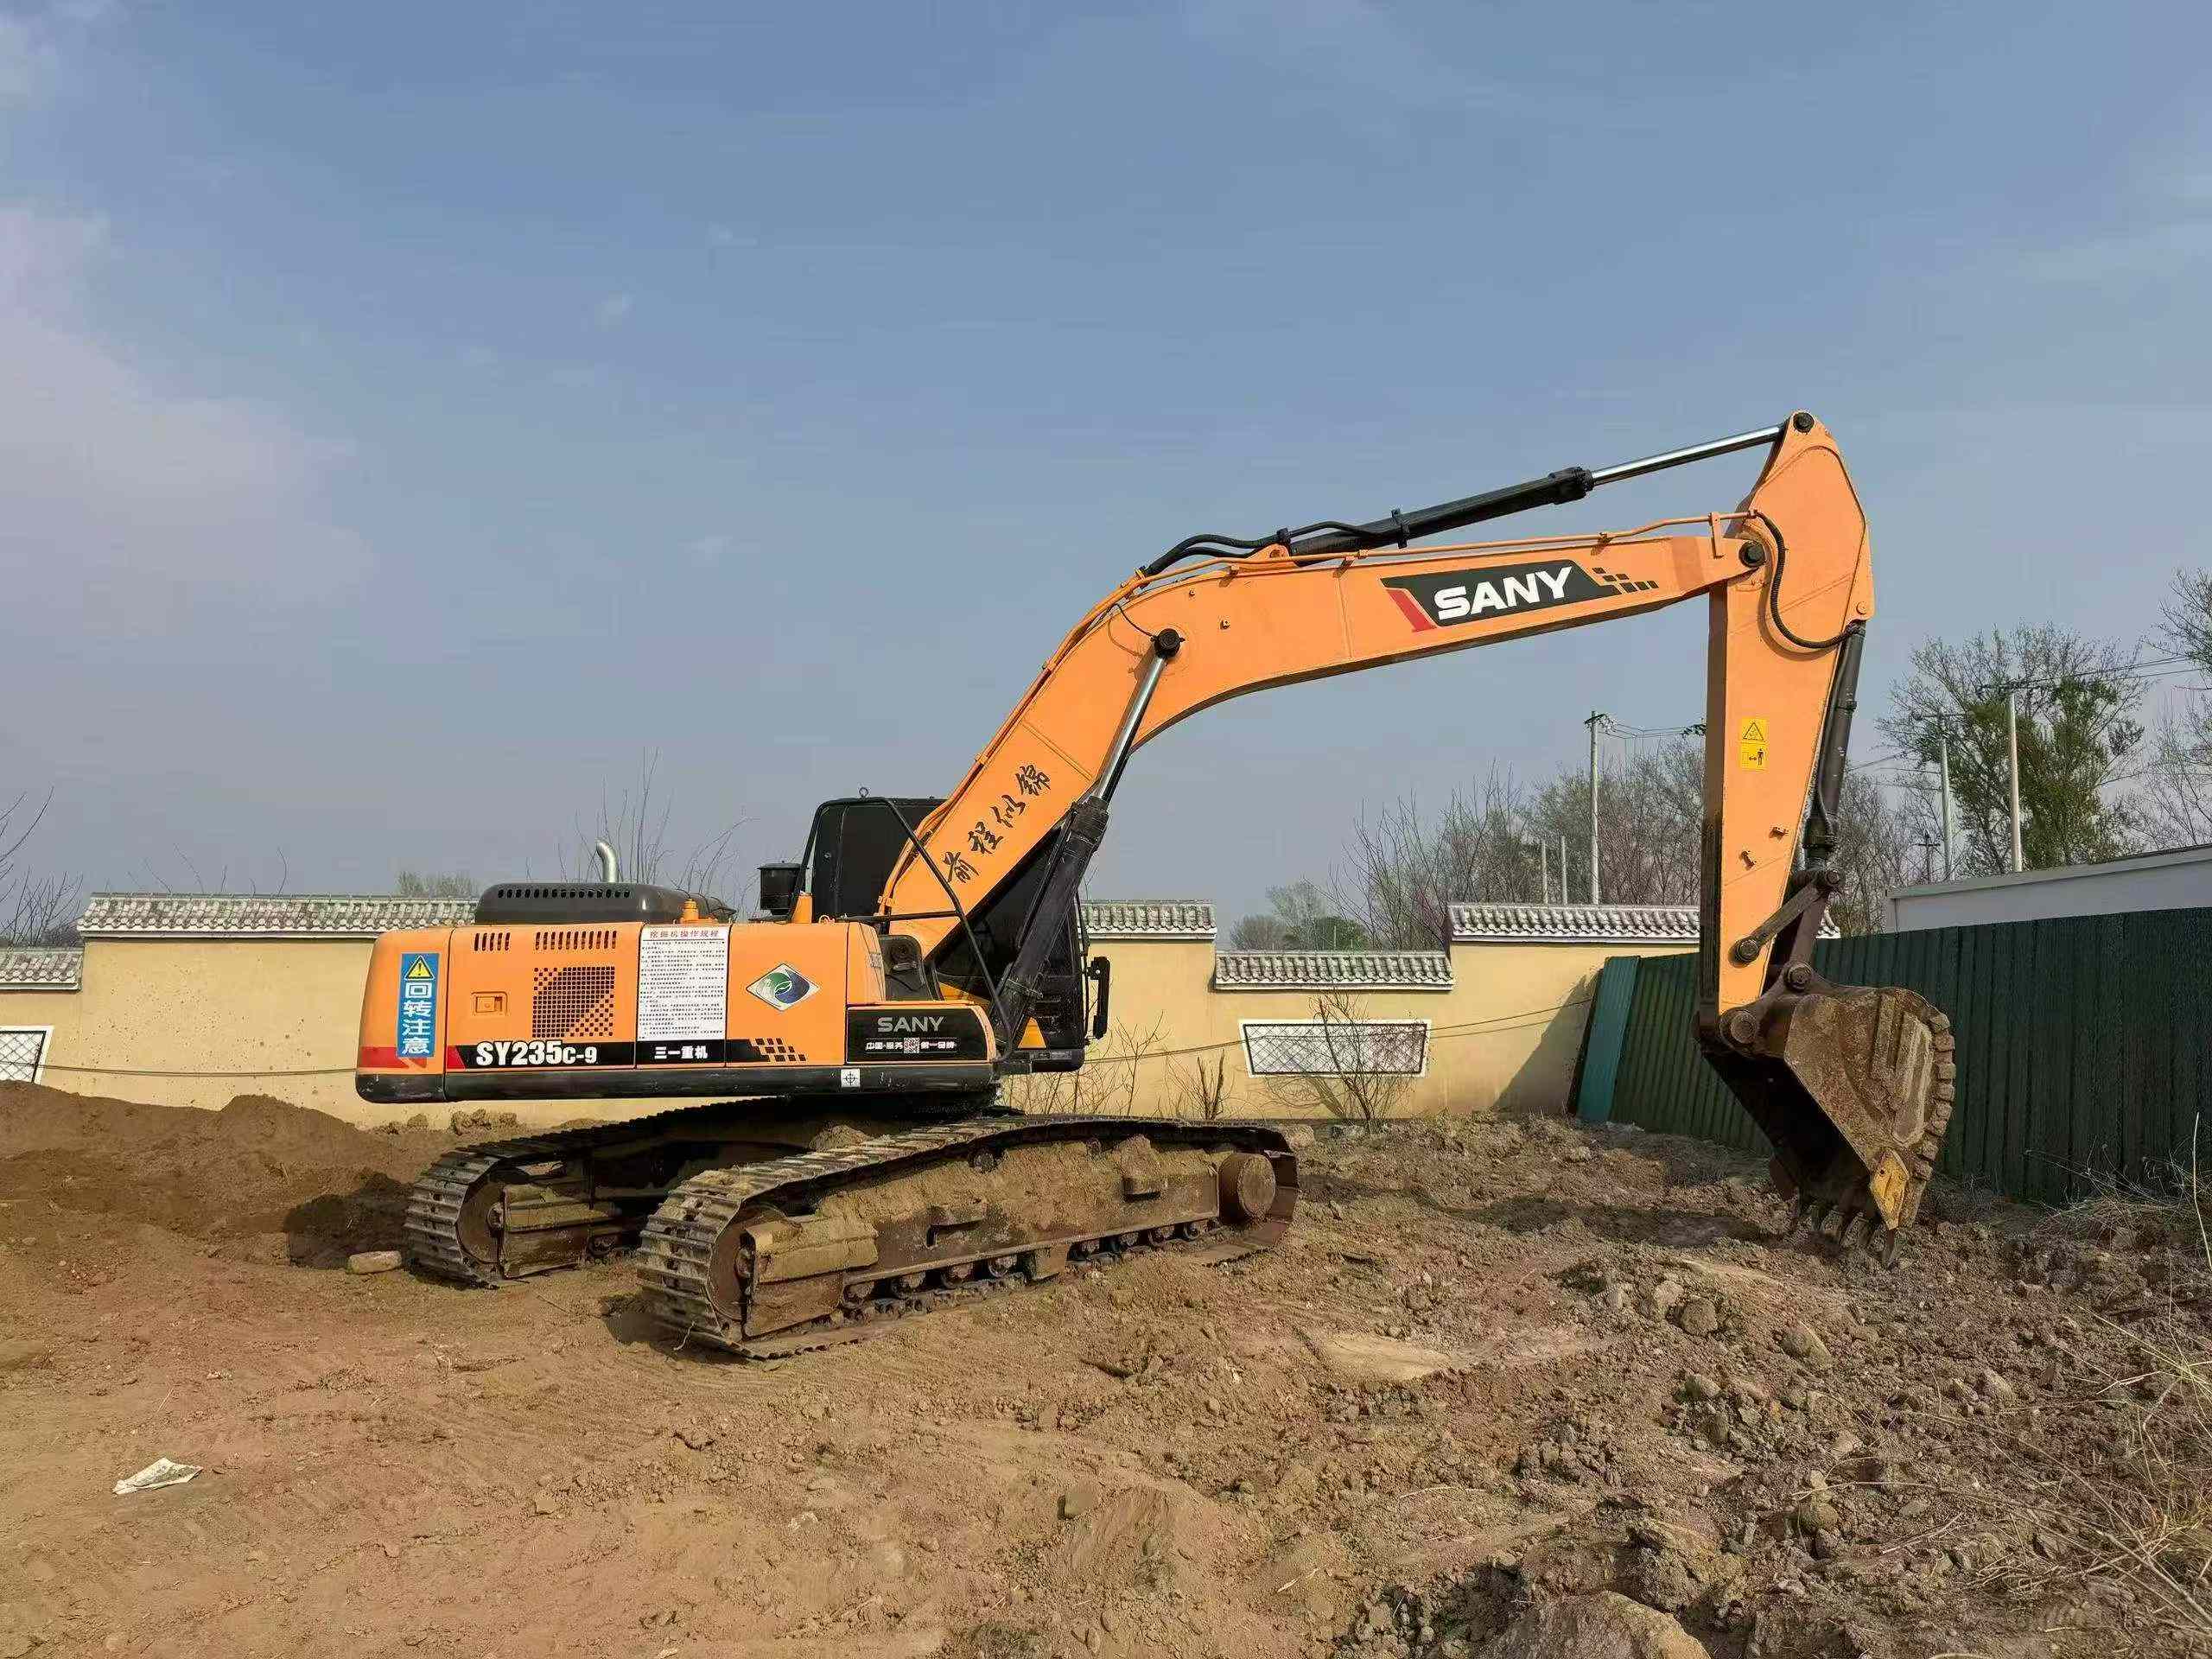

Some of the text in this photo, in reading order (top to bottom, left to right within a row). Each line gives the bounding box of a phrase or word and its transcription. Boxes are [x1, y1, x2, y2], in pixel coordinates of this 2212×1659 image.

[1433, 566, 1573, 620] SANY
[942, 764, 1051, 883] 前程似锦
[402, 982, 433, 1054] 回转注意
[877, 1016, 944, 1033] SANY
[654, 1046, 708, 1059] 三一重机
